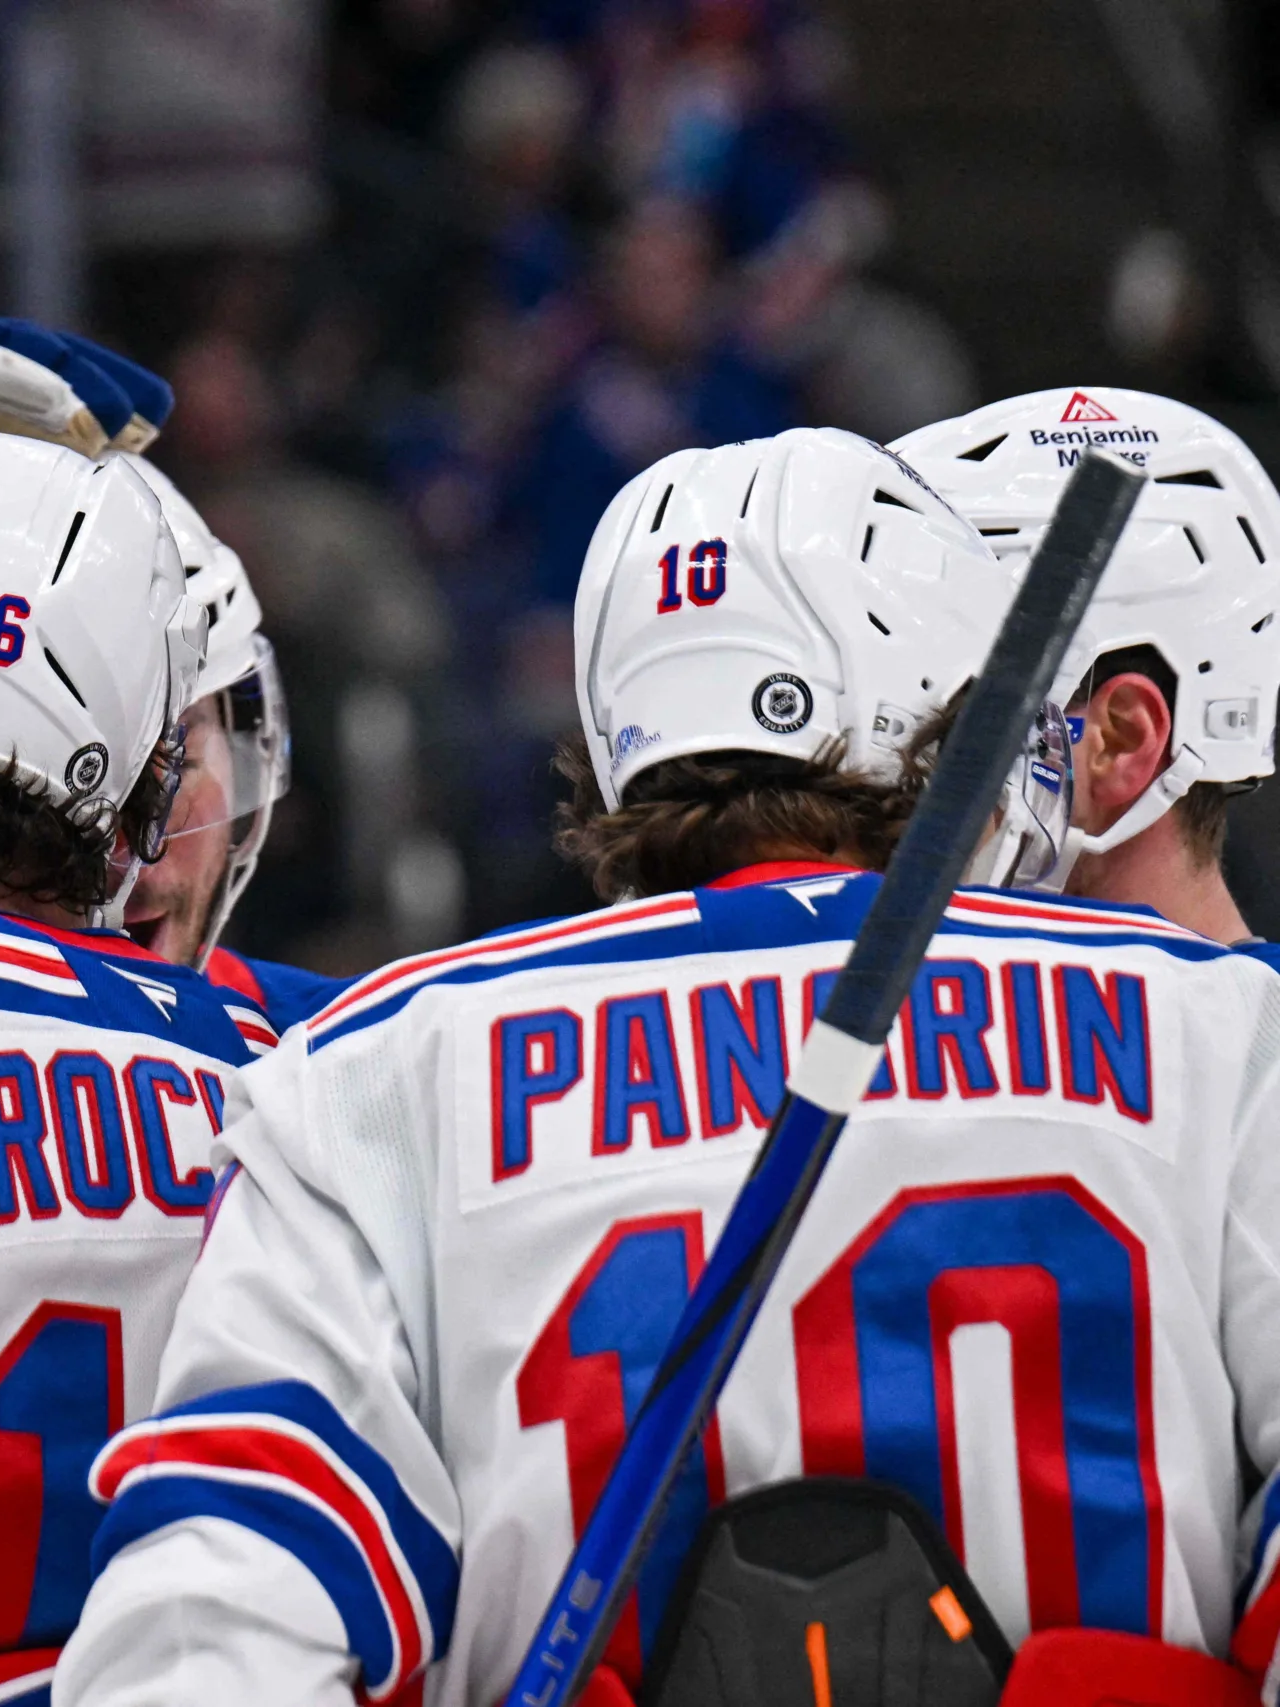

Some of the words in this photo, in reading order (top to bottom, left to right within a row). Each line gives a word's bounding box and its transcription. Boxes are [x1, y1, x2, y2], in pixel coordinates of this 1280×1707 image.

[1030, 425, 1159, 448] Benjamin
[657, 536, 727, 615] 10
[768, 673, 799, 684] UNITY
[758, 715, 805, 732] EQUALITY
[491, 958, 1153, 1183] PANRIN
[516, 1174, 1165, 1684] 10
